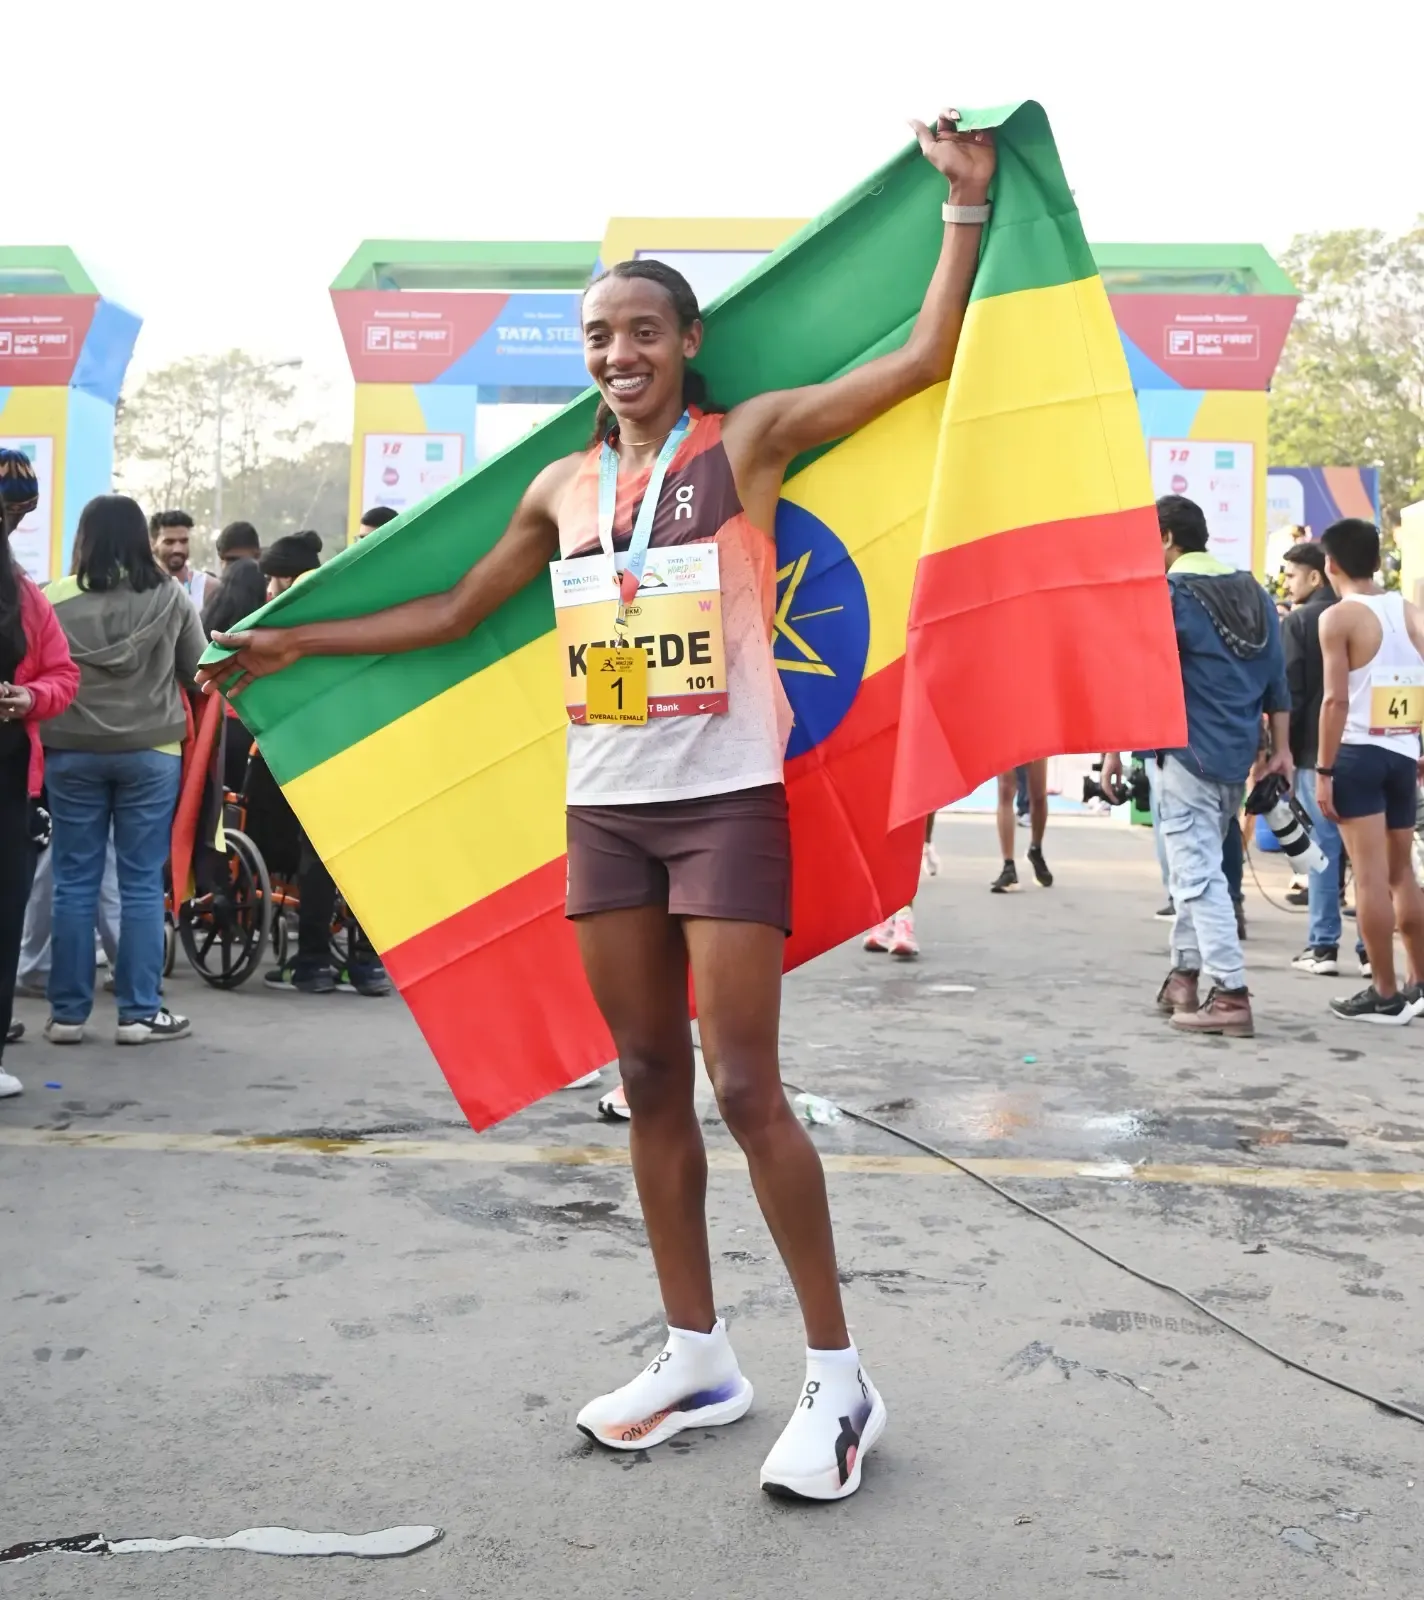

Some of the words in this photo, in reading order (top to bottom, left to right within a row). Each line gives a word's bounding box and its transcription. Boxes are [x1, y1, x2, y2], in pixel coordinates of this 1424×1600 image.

[496, 326, 543, 341] TATA
[546, 326, 584, 341] STEE
[1222, 333, 1254, 344] FIRST
[1197, 344, 1223, 355] Bank
[562, 578, 582, 587] TATA
[698, 600, 712, 612] W
[568, 630, 712, 678] KEDE
[685, 675, 715, 690] 101
[610, 676, 623, 710] 1
[656, 703, 680, 713] Bank
[1388, 697, 1408, 719] 41
[589, 713, 619, 721] OVERALL
[619, 714, 645, 722] FEMALE
